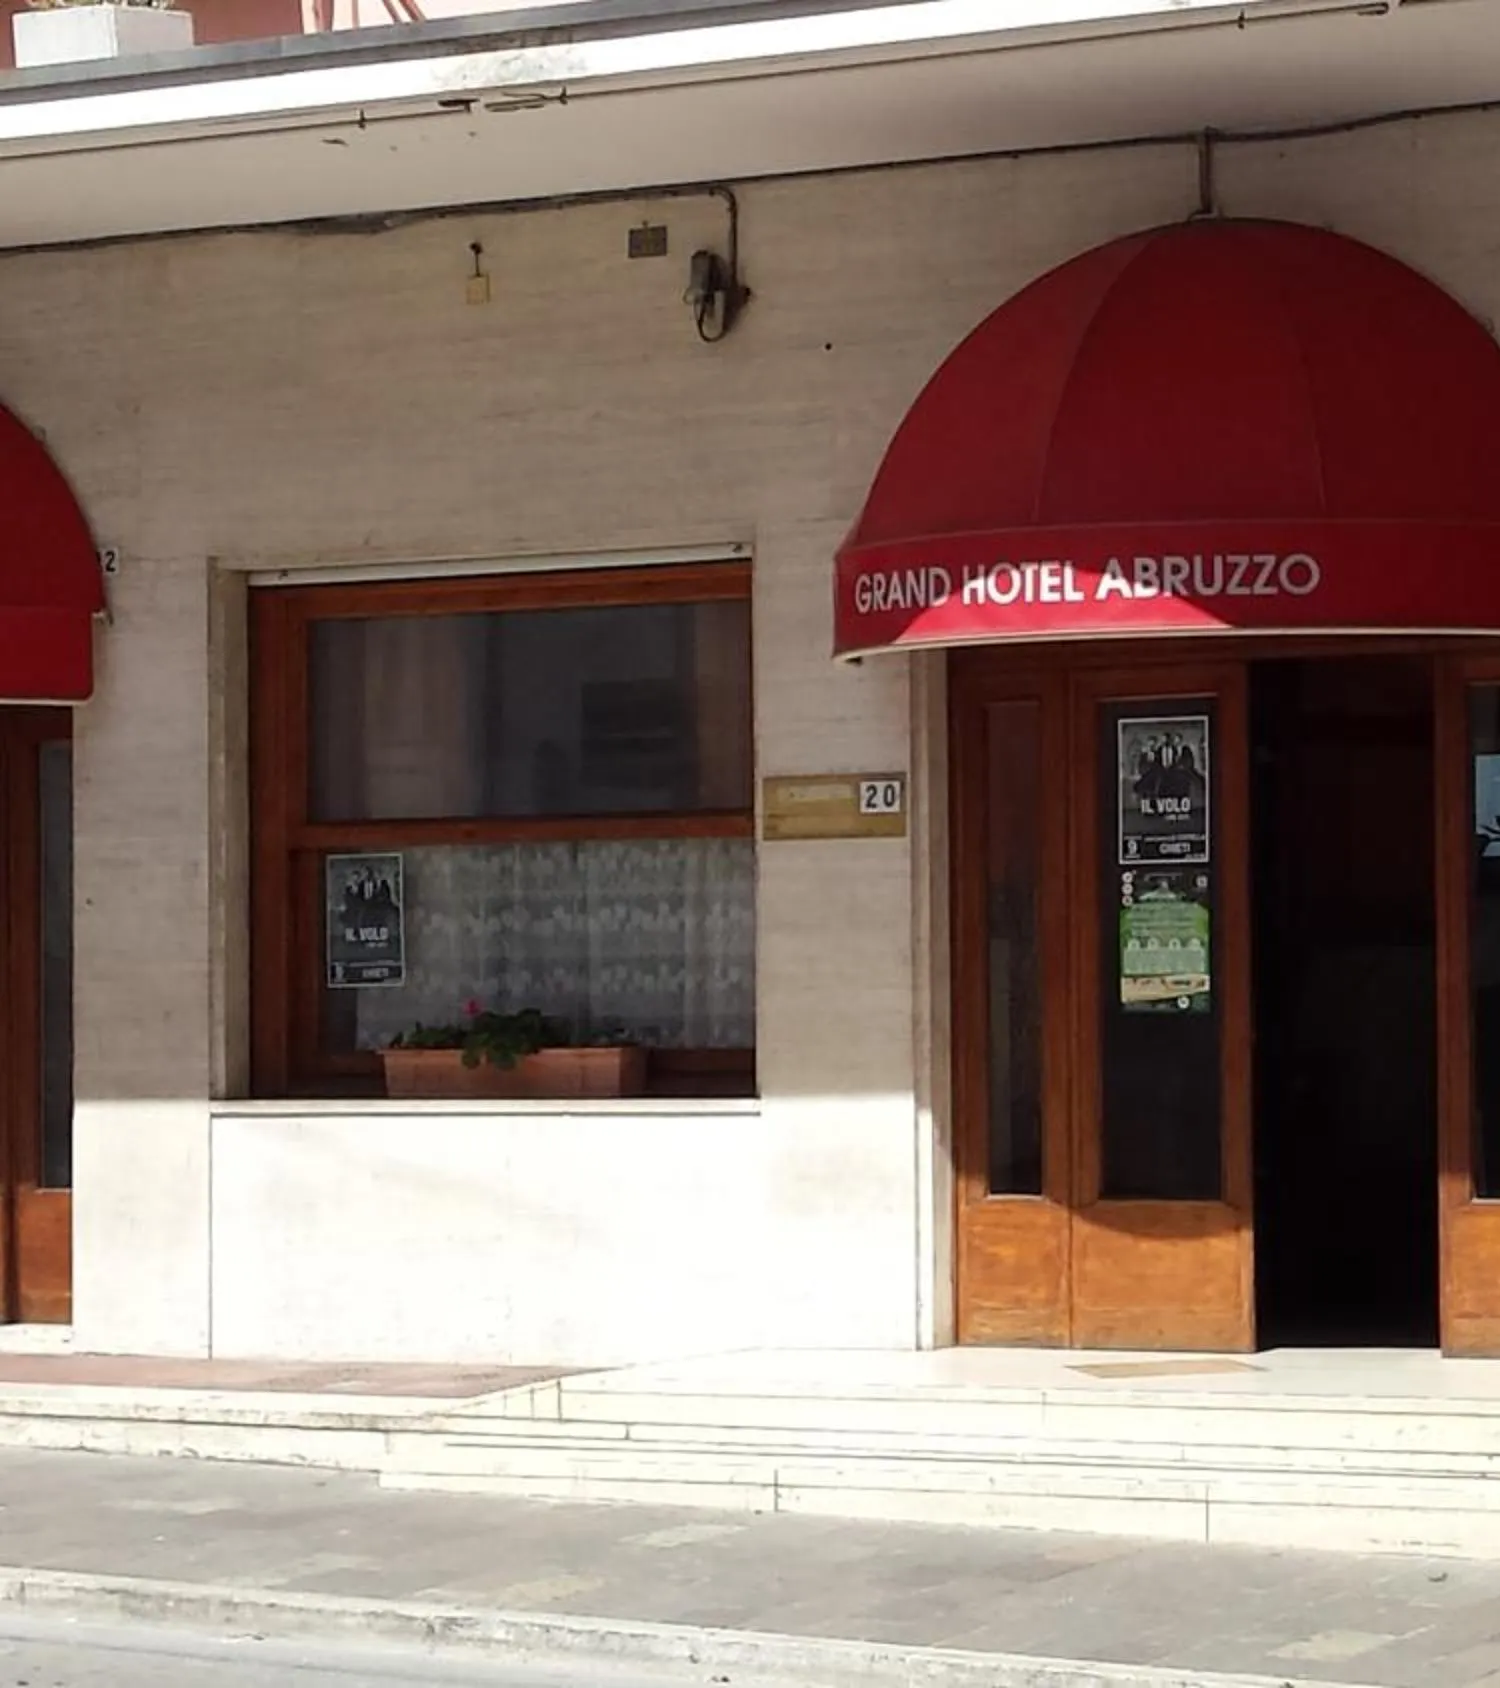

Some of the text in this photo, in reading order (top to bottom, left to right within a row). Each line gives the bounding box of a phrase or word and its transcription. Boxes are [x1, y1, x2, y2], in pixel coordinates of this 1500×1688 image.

[855, 553, 1321, 613] GRAND HOTEL ABRUZZO
[866, 784, 896, 808] 20
[1141, 797, 1191, 813] IL VOLO
